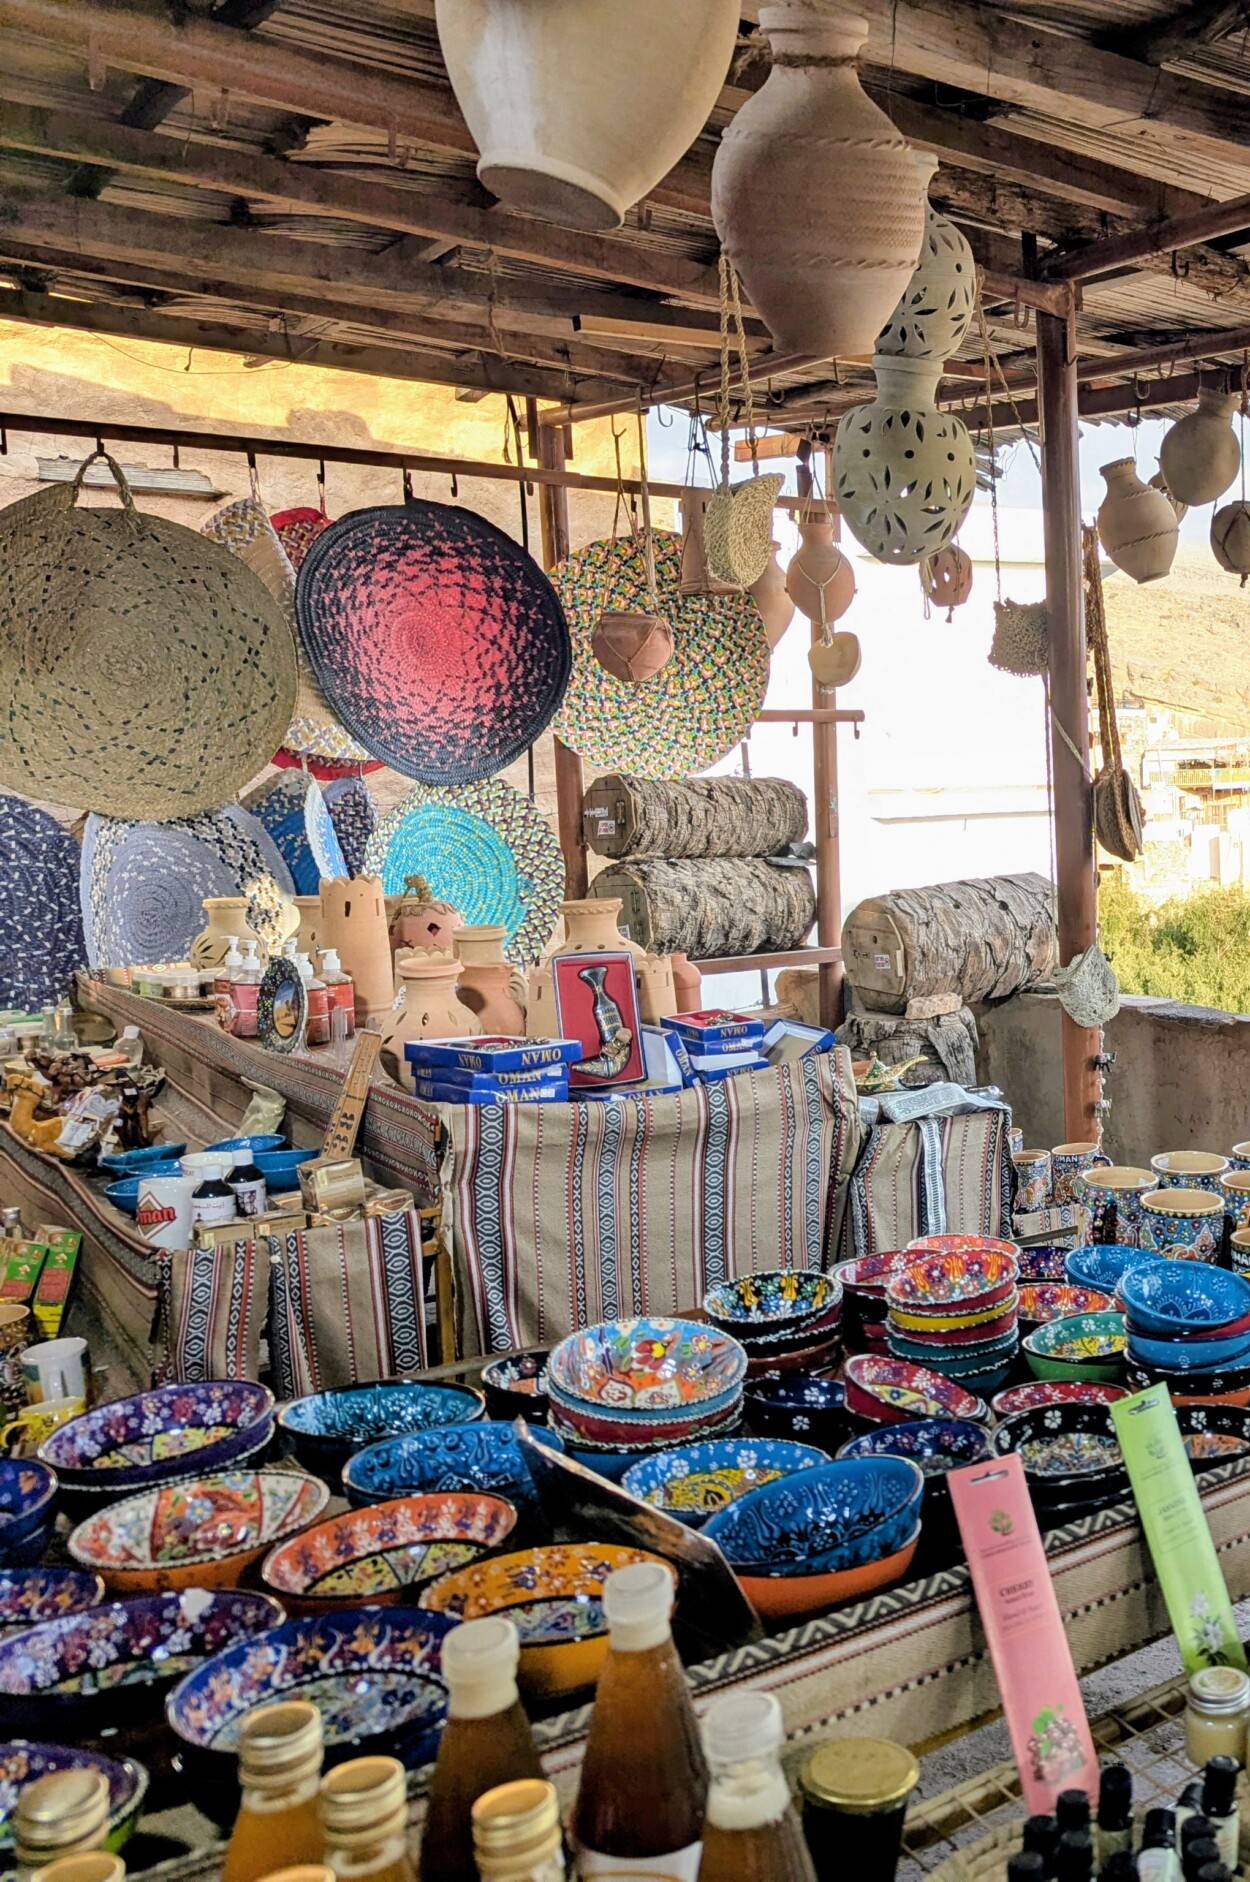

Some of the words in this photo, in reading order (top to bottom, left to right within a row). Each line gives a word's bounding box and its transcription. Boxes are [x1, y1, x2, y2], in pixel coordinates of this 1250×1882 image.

[721, 1026, 748, 1038] OMAN
[458, 1053, 482, 1069] OMAN
[521, 1047, 562, 1066] OMAN
[675, 1049, 694, 1077] OMAN
[498, 1069, 542, 1086] OMAN
[495, 1086, 541, 1104] OMAN
[139, 1206, 177, 1226] man
